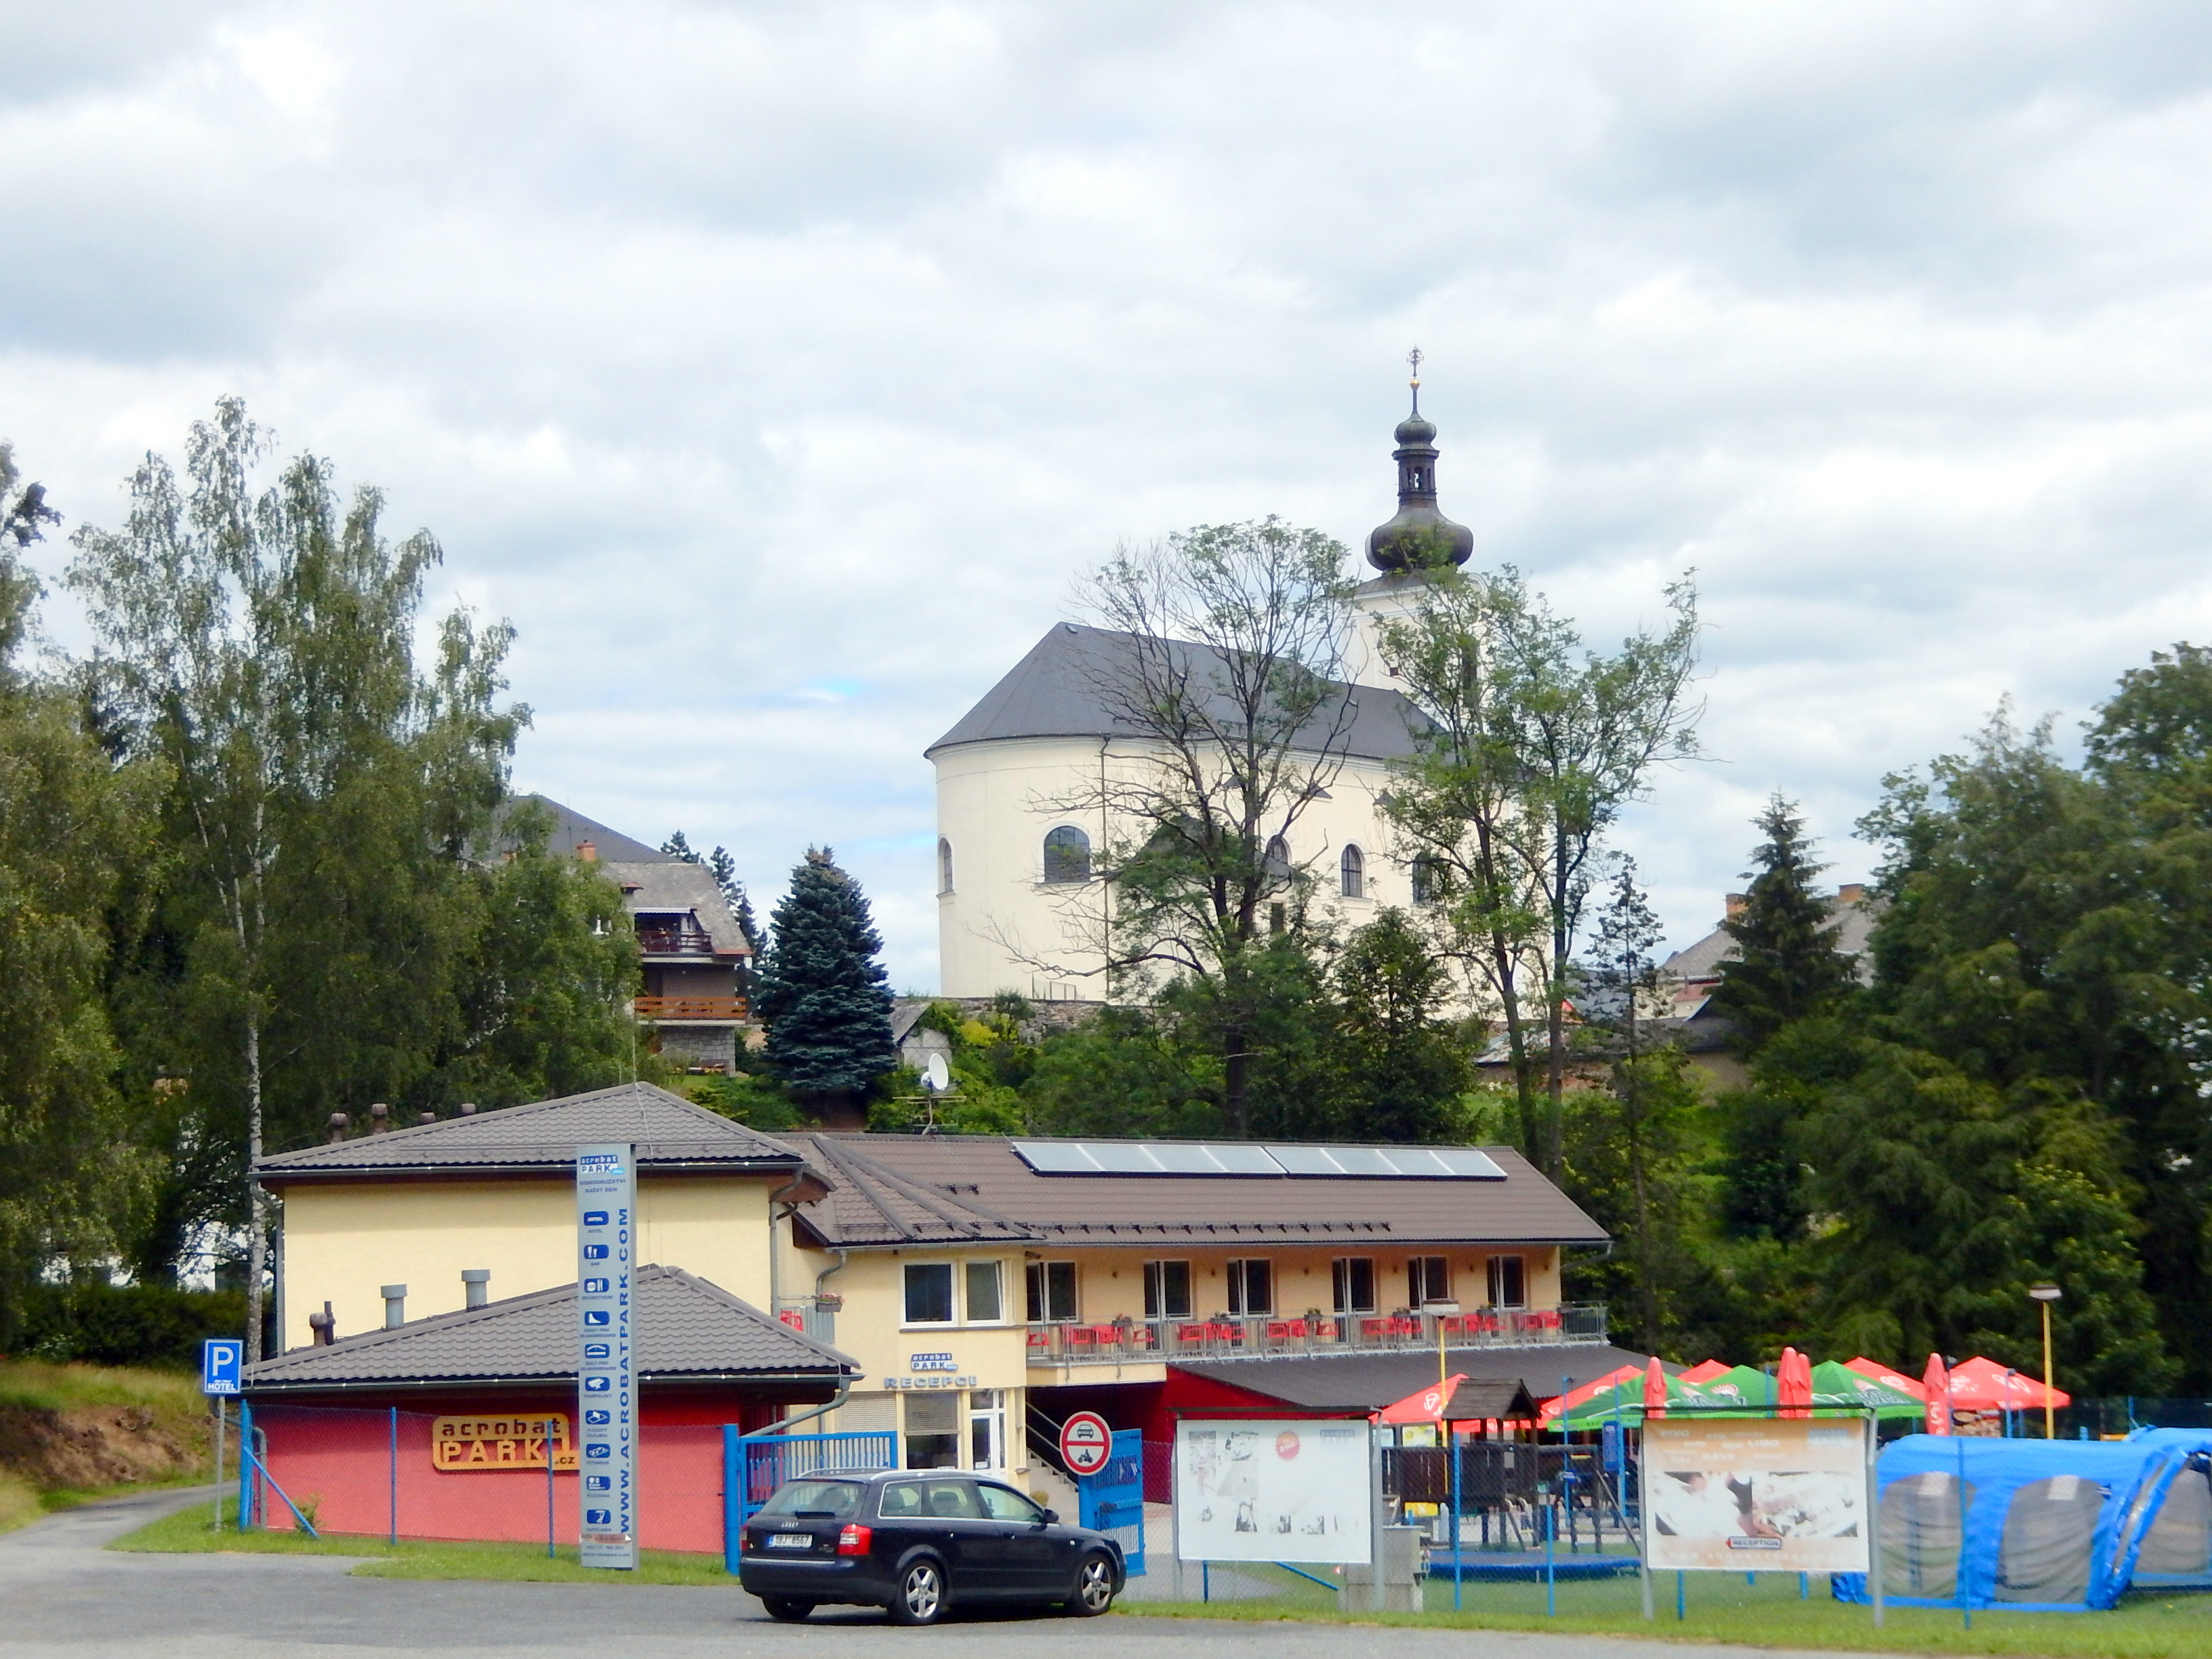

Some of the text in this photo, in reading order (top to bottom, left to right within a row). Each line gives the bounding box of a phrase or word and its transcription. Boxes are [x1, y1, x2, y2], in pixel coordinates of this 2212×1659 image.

[581, 1155, 617, 1164] acrobat
[581, 1164, 611, 1174] PARK
[212, 1347, 234, 1376] P
[619, 1208, 630, 1534] WWW.ACROBATPARK.COM
[207, 1382, 237, 1391] HOTEL
[884, 1375, 978, 1389] RECEPCE
[442, 1418, 561, 1437] acrobat
[443, 1440, 546, 1462] PARK
[1732, 1538, 1779, 1547] RECEPTION
